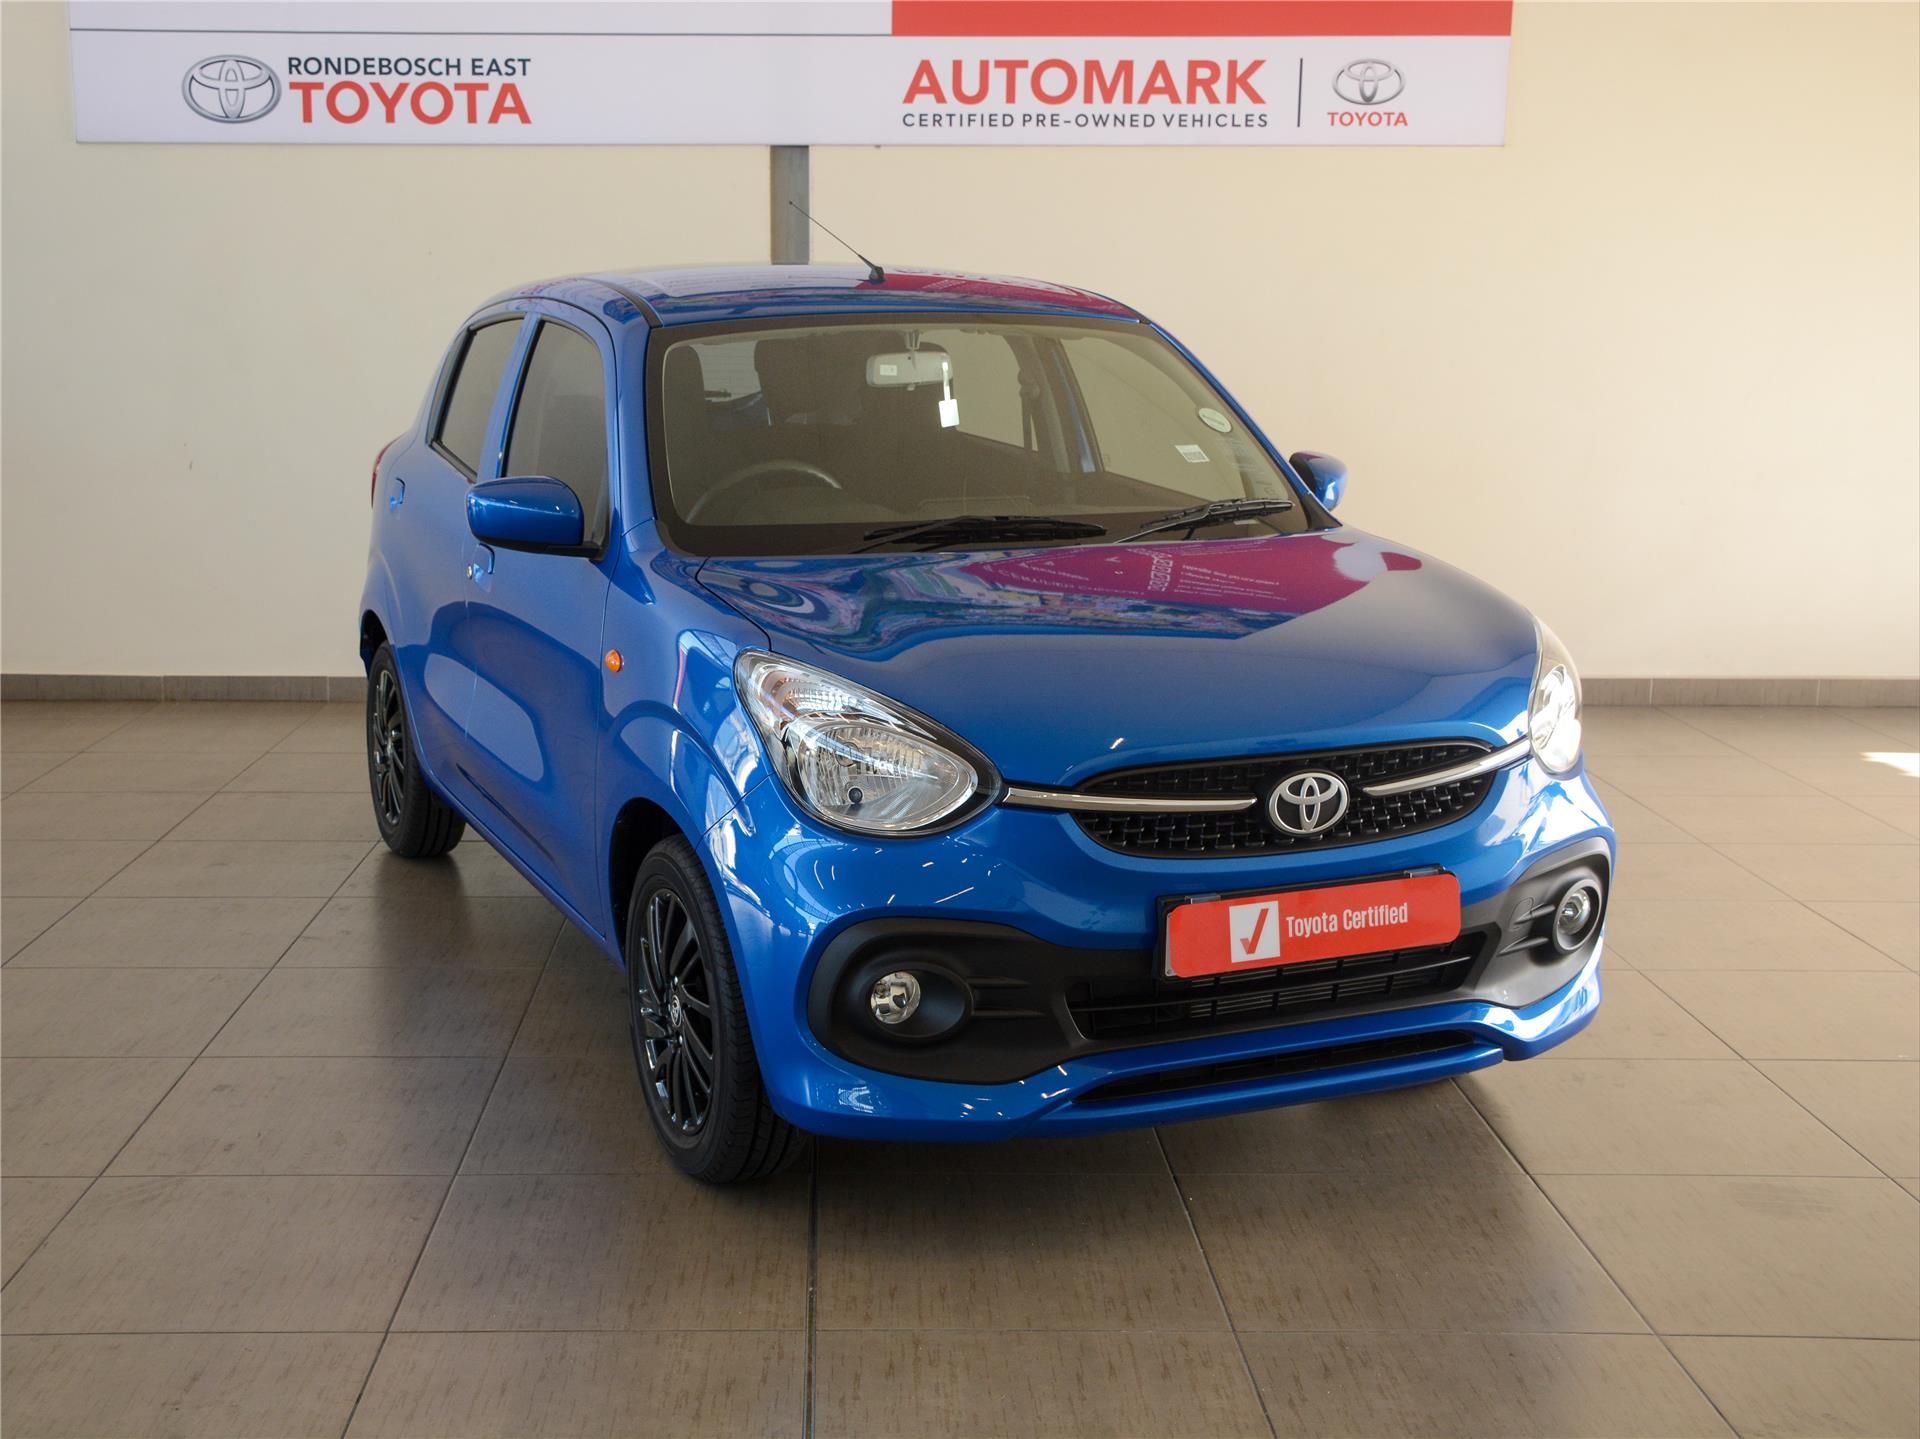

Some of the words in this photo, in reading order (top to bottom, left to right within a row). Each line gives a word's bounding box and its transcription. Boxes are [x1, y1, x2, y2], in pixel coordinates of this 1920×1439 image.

[287, 56, 462, 77] RONDEBOSCH
[471, 57, 532, 77] EAST
[903, 58, 1265, 106] AUTOMARK
[288, 80, 532, 125] TOYOTA
[902, 113, 1015, 128] CERTIFIED
[1022, 113, 1156, 128] PRE-OWNED
[1162, 113, 1268, 128] VEHICLES
[1327, 111, 1409, 127] TOYOTA
[1285, 911, 1339, 938] Toyota
[1342, 902, 1409, 931] Certified
